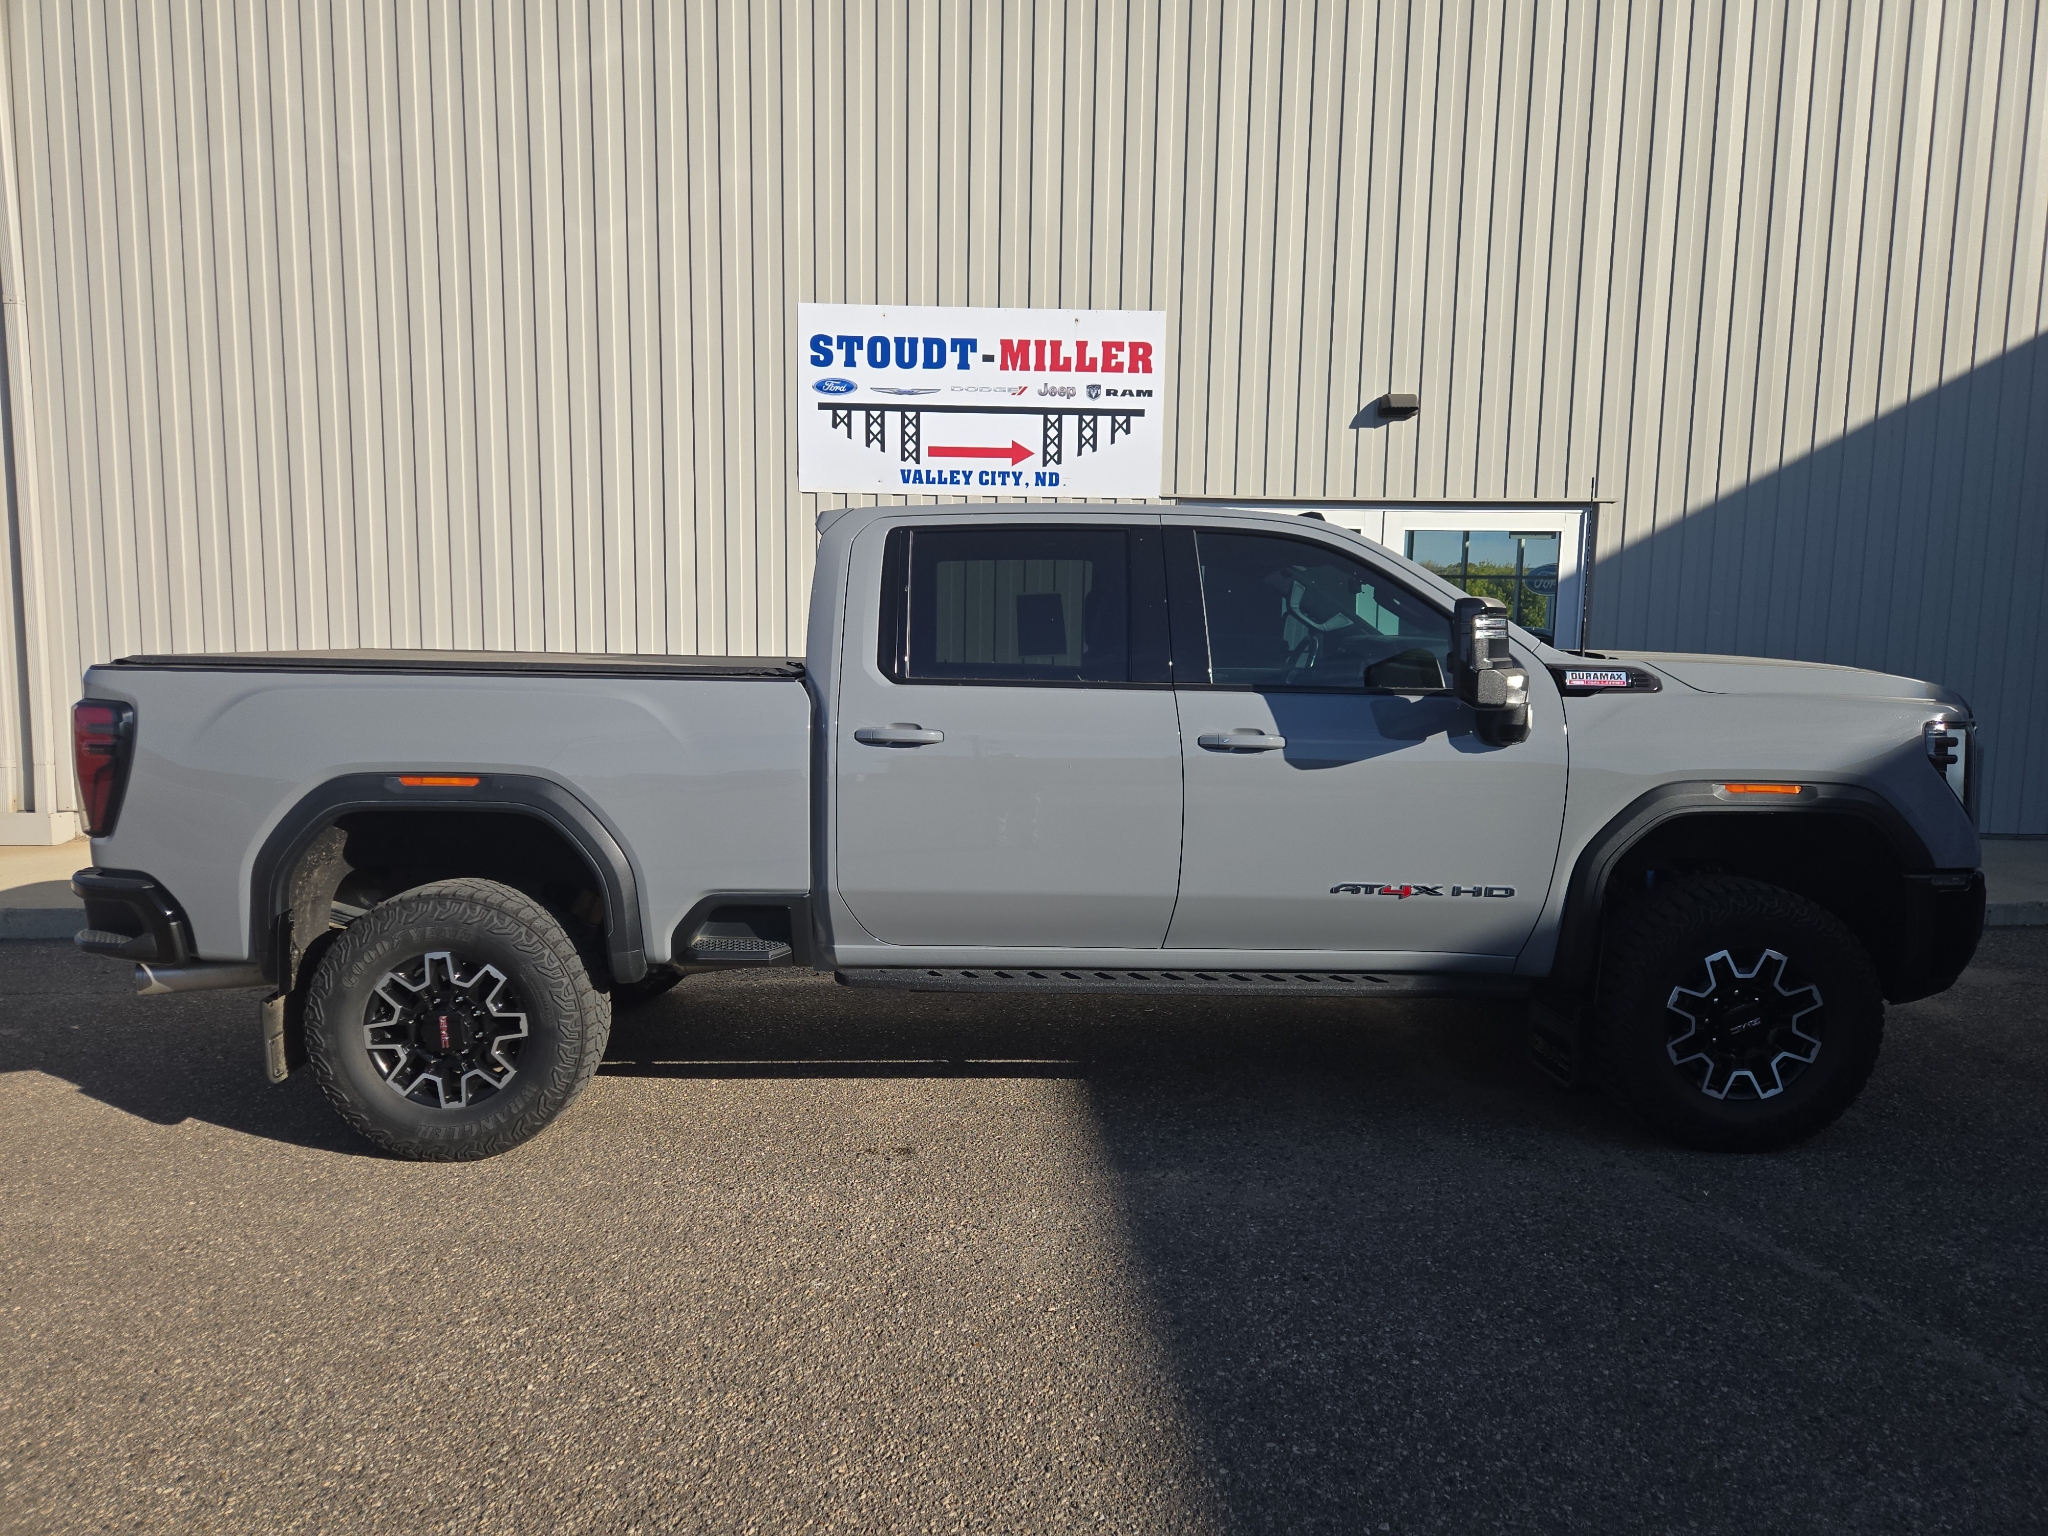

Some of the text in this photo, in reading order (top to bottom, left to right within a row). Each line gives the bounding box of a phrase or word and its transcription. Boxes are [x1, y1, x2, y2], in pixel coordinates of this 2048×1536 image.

[810, 334, 1153, 374] STOUDT-MILLER
[950, 385, 1019, 394] DODGE
[1037, 383, 1077, 400] Jeep
[1105, 388, 1153, 398] RAM
[900, 469, 1060, 489] VALLEY CITY, ND
[1533, 570, 1557, 589] For
[1570, 672, 1623, 681] DURAMAX
[1329, 882, 1516, 900] AT4X HD
[438, 1014, 450, 1049] GMC
[416, 1081, 539, 1140] WRANGLER
